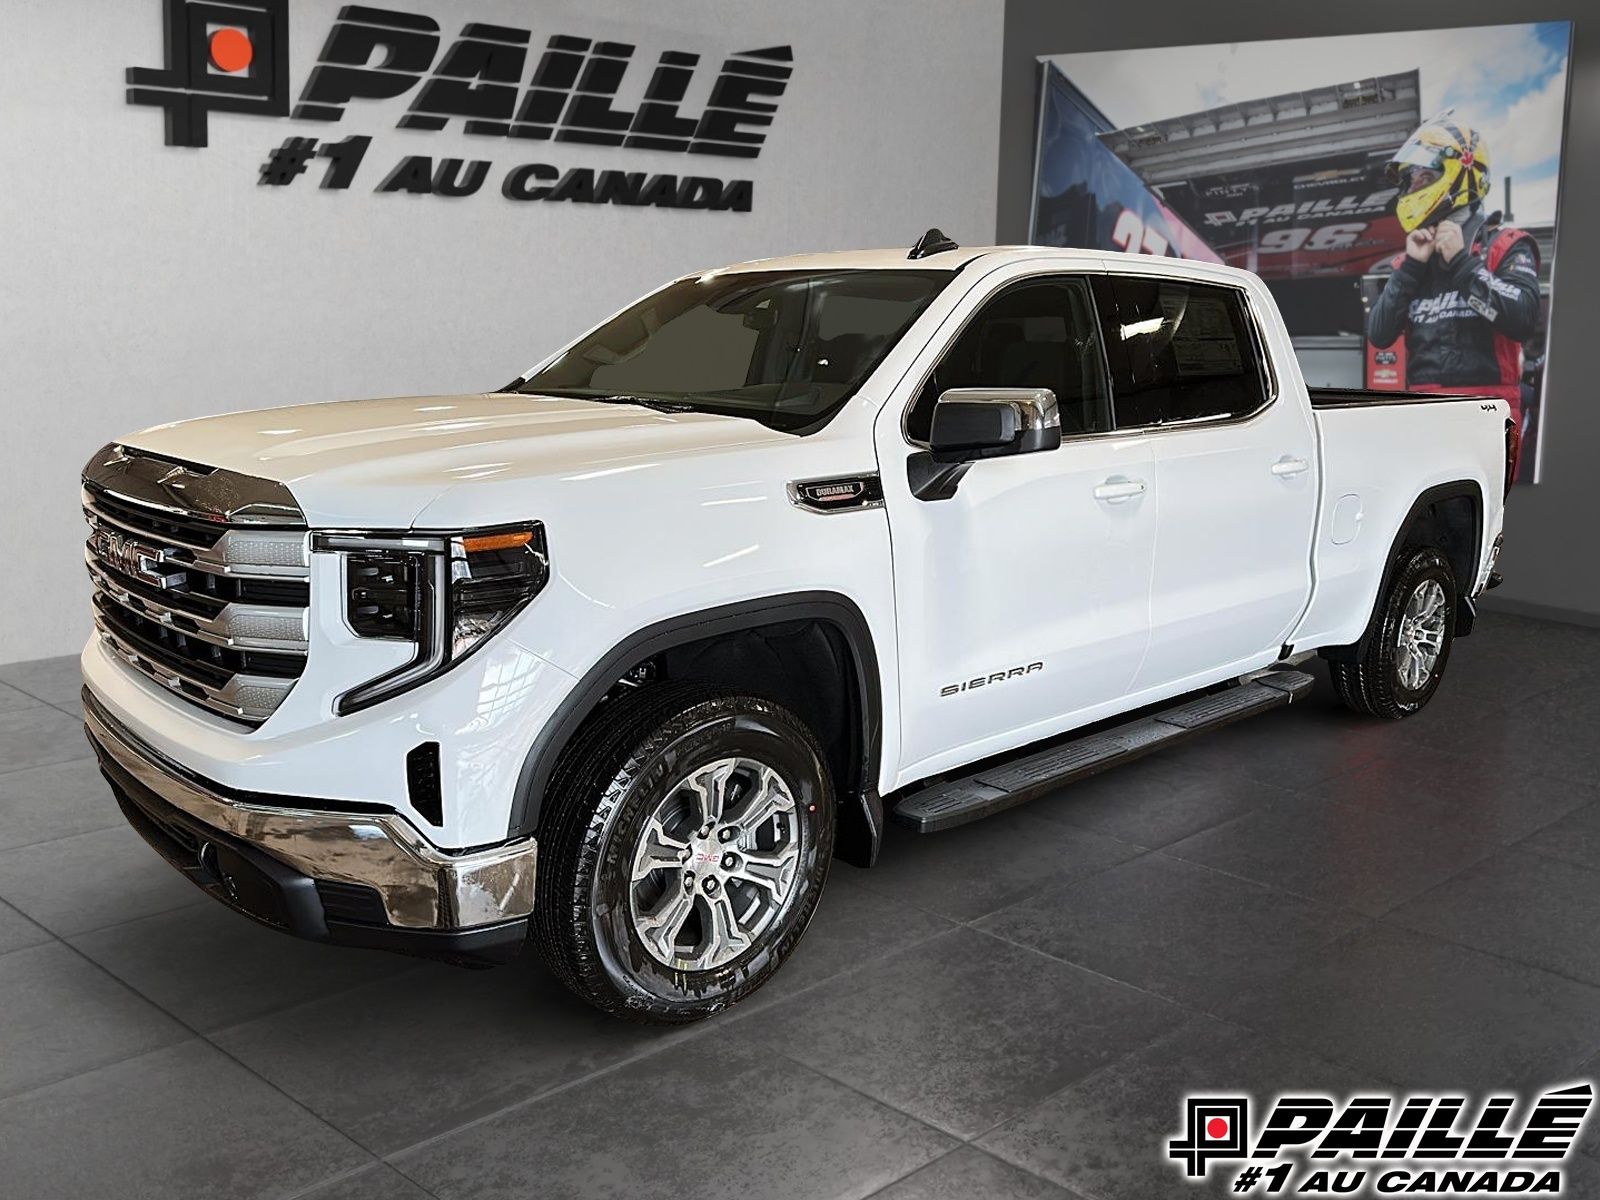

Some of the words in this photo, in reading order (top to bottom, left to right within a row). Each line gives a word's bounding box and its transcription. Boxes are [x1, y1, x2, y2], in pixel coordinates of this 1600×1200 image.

[290, 4, 793, 159] PAILLÉ
[257, 135, 373, 190] #1
[374, 156, 492, 196] AU
[503, 163, 754, 212] CANADA
[1263, 215, 1291, 224] AU
[1296, 206, 1386, 220] CANADA
[1257, 222, 1368, 253] 96
[815, 484, 855, 496] DURAMAX
[940, 661, 1044, 697] SIERRA
